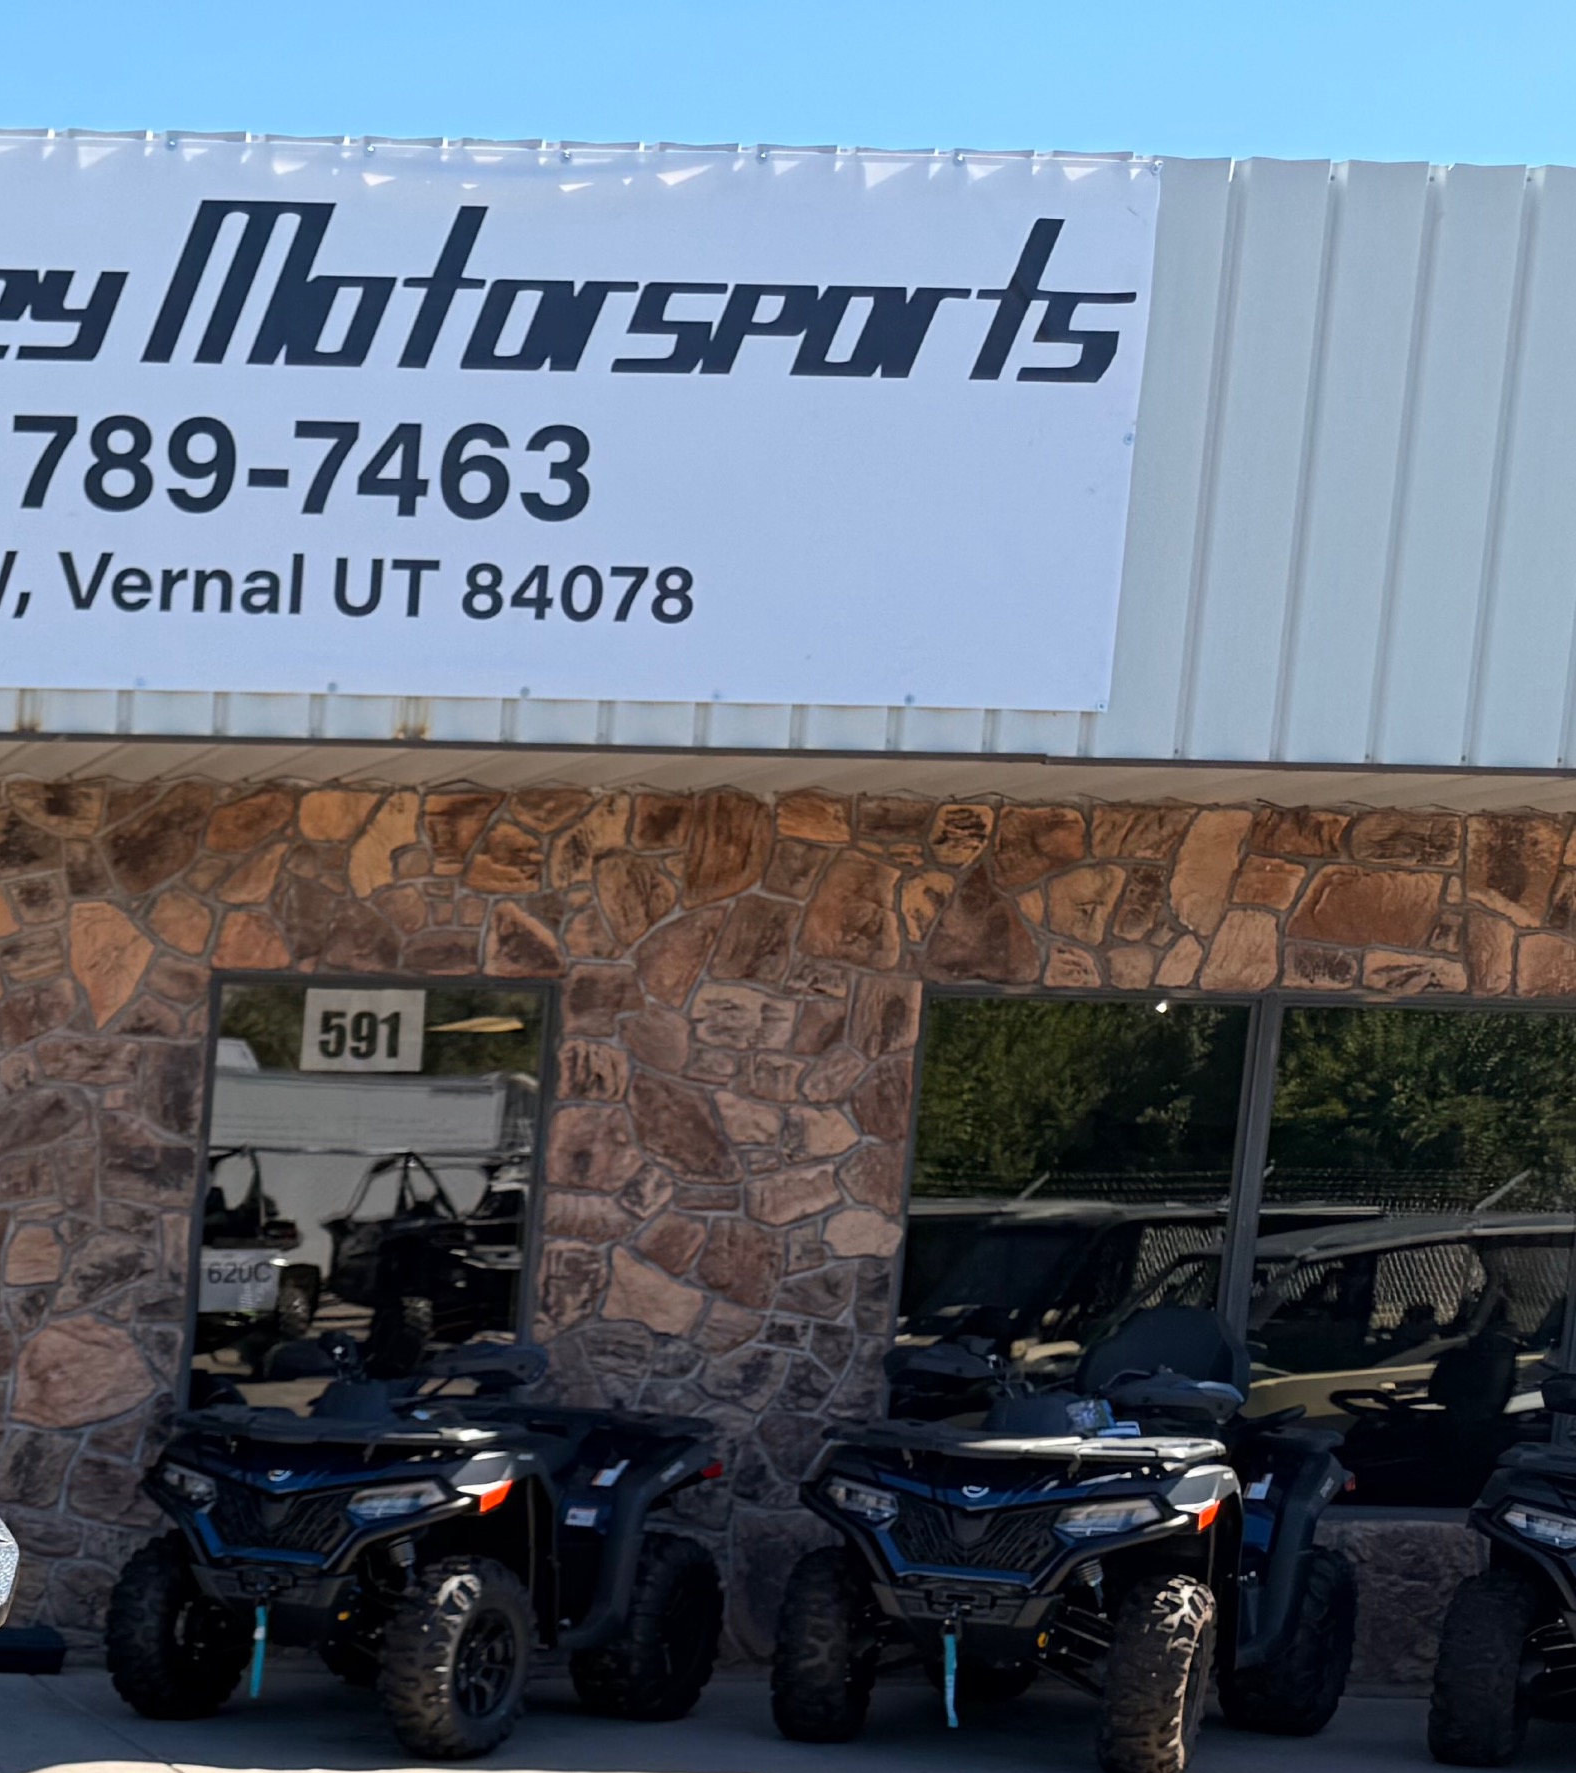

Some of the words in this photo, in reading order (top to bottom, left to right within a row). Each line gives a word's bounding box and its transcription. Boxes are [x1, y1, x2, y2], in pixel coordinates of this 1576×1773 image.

[139, 198, 1138, 384] Motorsports
[12, 413, 591, 523] 789-7463
[57, 550, 306, 616] Vernal
[333, 556, 442, 618] UT
[461, 561, 695, 625] 84078
[318, 1010, 402, 1060] 591
